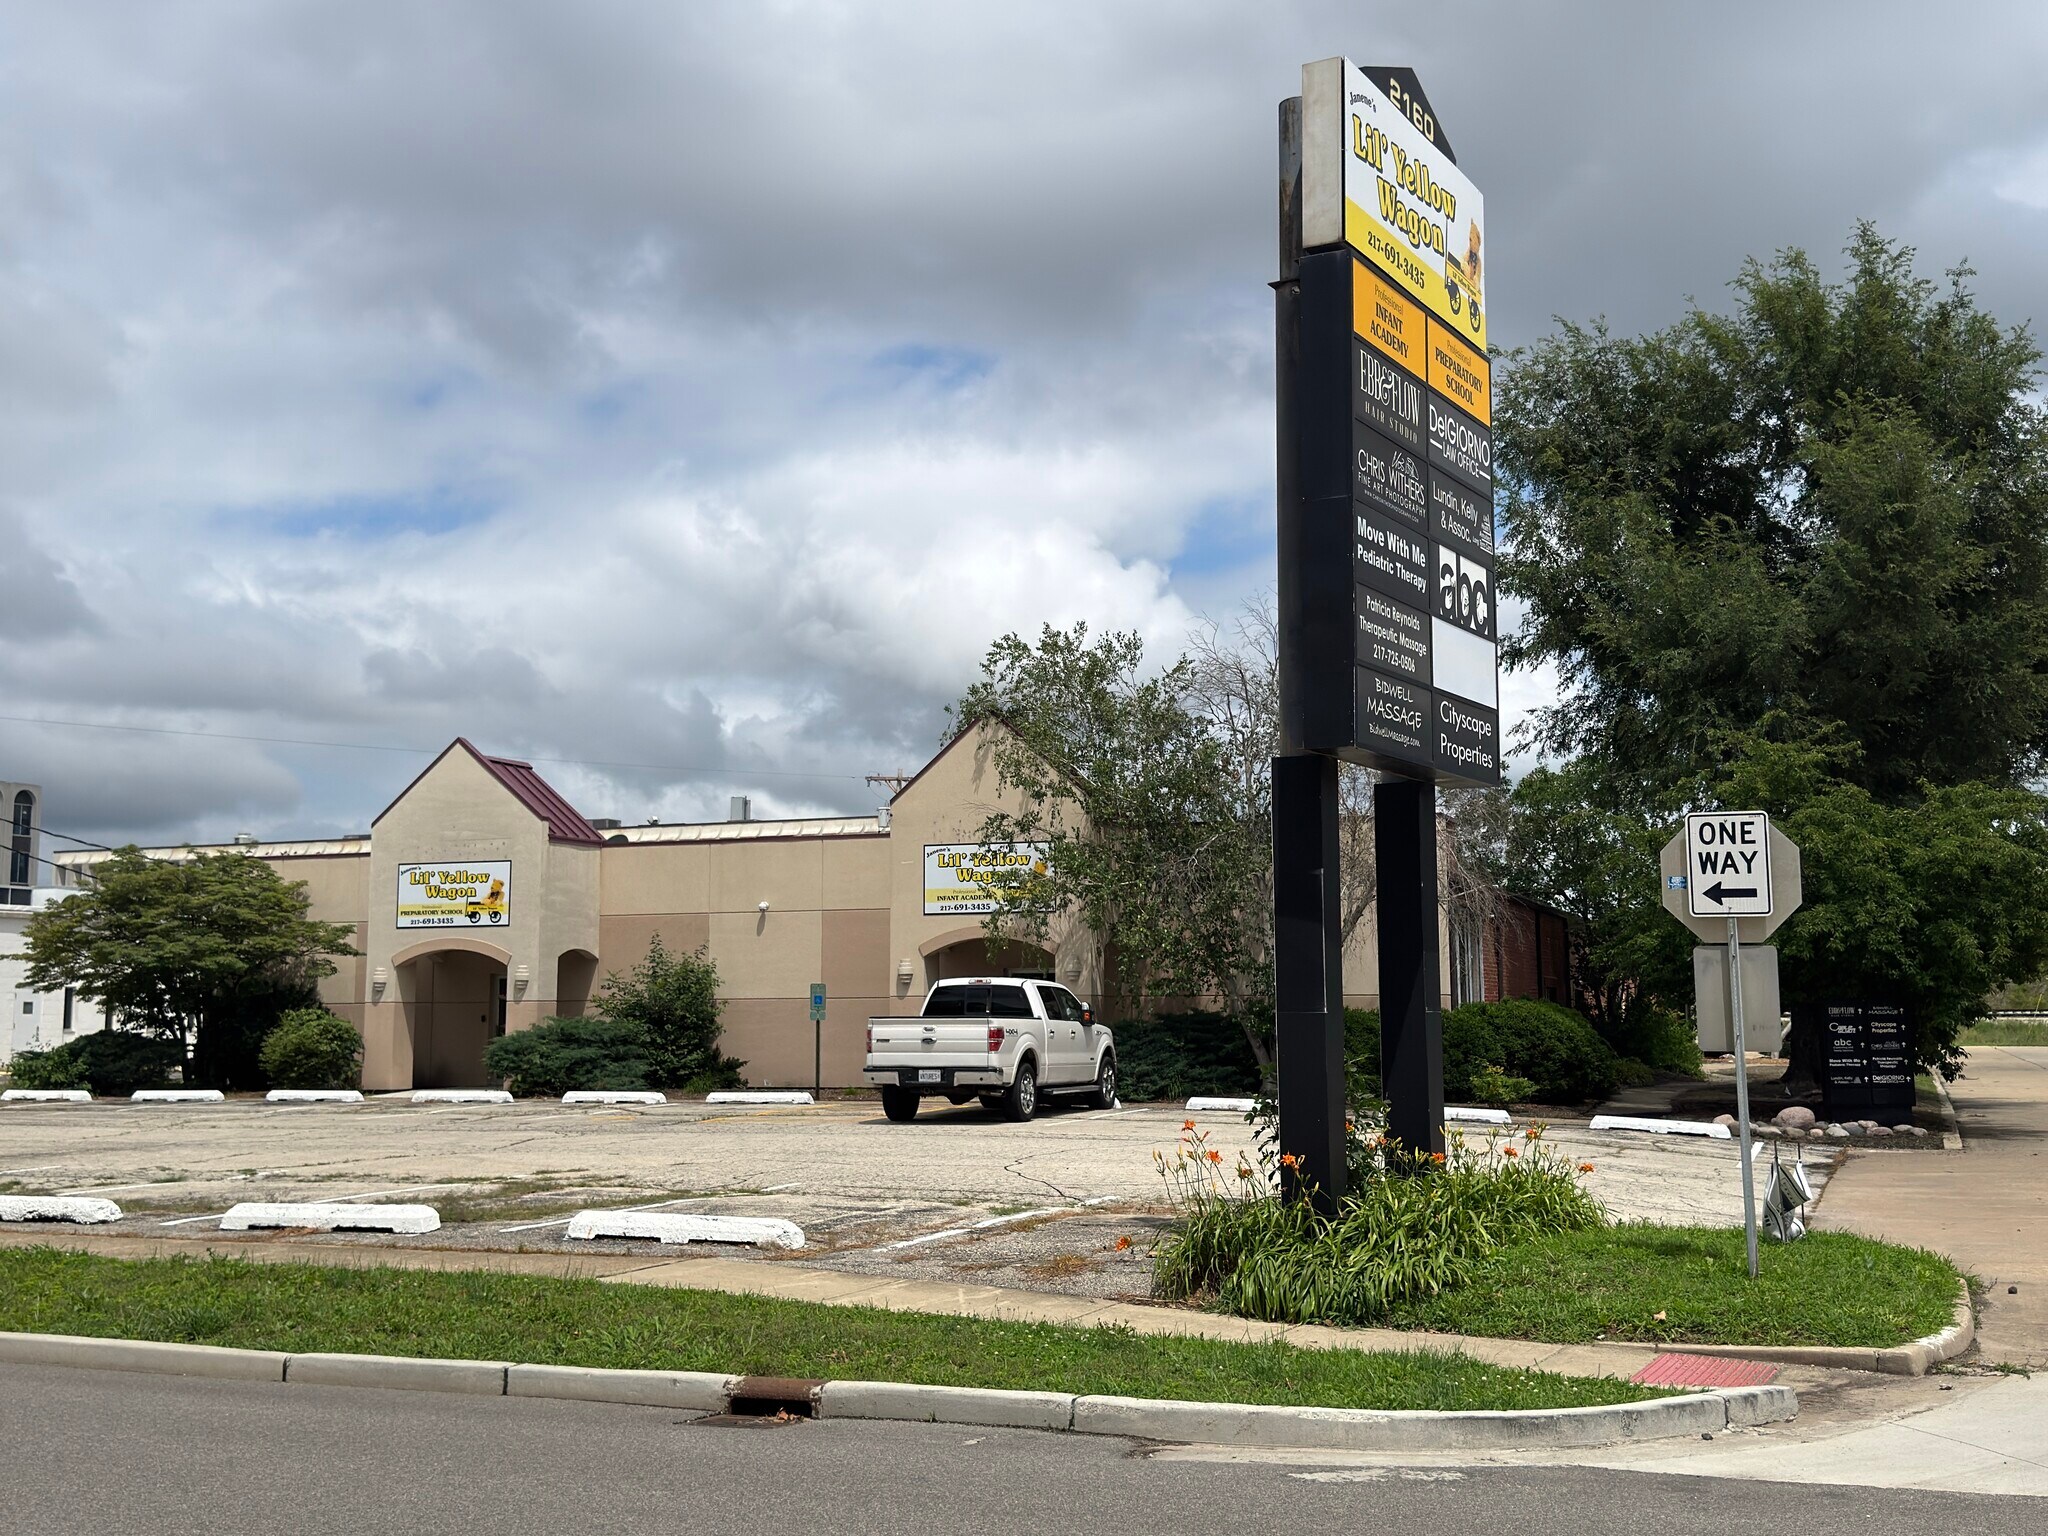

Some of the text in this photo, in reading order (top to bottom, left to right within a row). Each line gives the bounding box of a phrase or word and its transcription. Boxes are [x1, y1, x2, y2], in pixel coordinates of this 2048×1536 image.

[1389, 77, 1434, 142] 2160
[1352, 113, 1456, 223] Lil' Yellow
[1376, 175, 1444, 257] Wagon
[1368, 231, 1425, 289] 217-691-3435
[1374, 284, 1403, 315] Professional
[1376, 302, 1403, 334] INFANT
[1370, 320, 1408, 358] ACADEMY
[1436, 347, 1482, 393] PREPARATORY
[1446, 374, 1474, 406] SCHOOL
[1365, 401, 1418, 444] HAIR STUDIO
[1430, 404, 1490, 466] DelGIORNO
[1358, 449, 1425, 506] CHRIS WITHERS
[1443, 442, 1480, 478] LAW OFFICE
[1358, 472, 1426, 518] FINE ART PHOTOGRAPHY
[1433, 481, 1478, 527] Lundin, Kelly
[1358, 516, 1426, 568] Move With Me
[1440, 510, 1447, 530] &
[1448, 515, 1472, 543] Assoc.
[1358, 544, 1426, 594] Pediatric Therapy
[1366, 595, 1420, 631] Patricia Reynolds
[1360, 615, 1426, 656] Therapeutic Massage
[1374, 644, 1415, 672] 217-725-0506
[1375, 678, 1413, 702] BIDWELL
[1367, 696, 1421, 732] MASSAGE
[1440, 701, 1492, 740] Cityscape
[1440, 733, 1492, 768] Properties
[1699, 822, 1756, 845] ONE
[410, 870, 490, 885] Lil' Yellow
[938, 852, 1031, 868] Lil' Yellow
[956, 868, 1003, 884] Wag
[1698, 851, 1758, 874] WAY
[426, 885, 476, 900] Wagon
